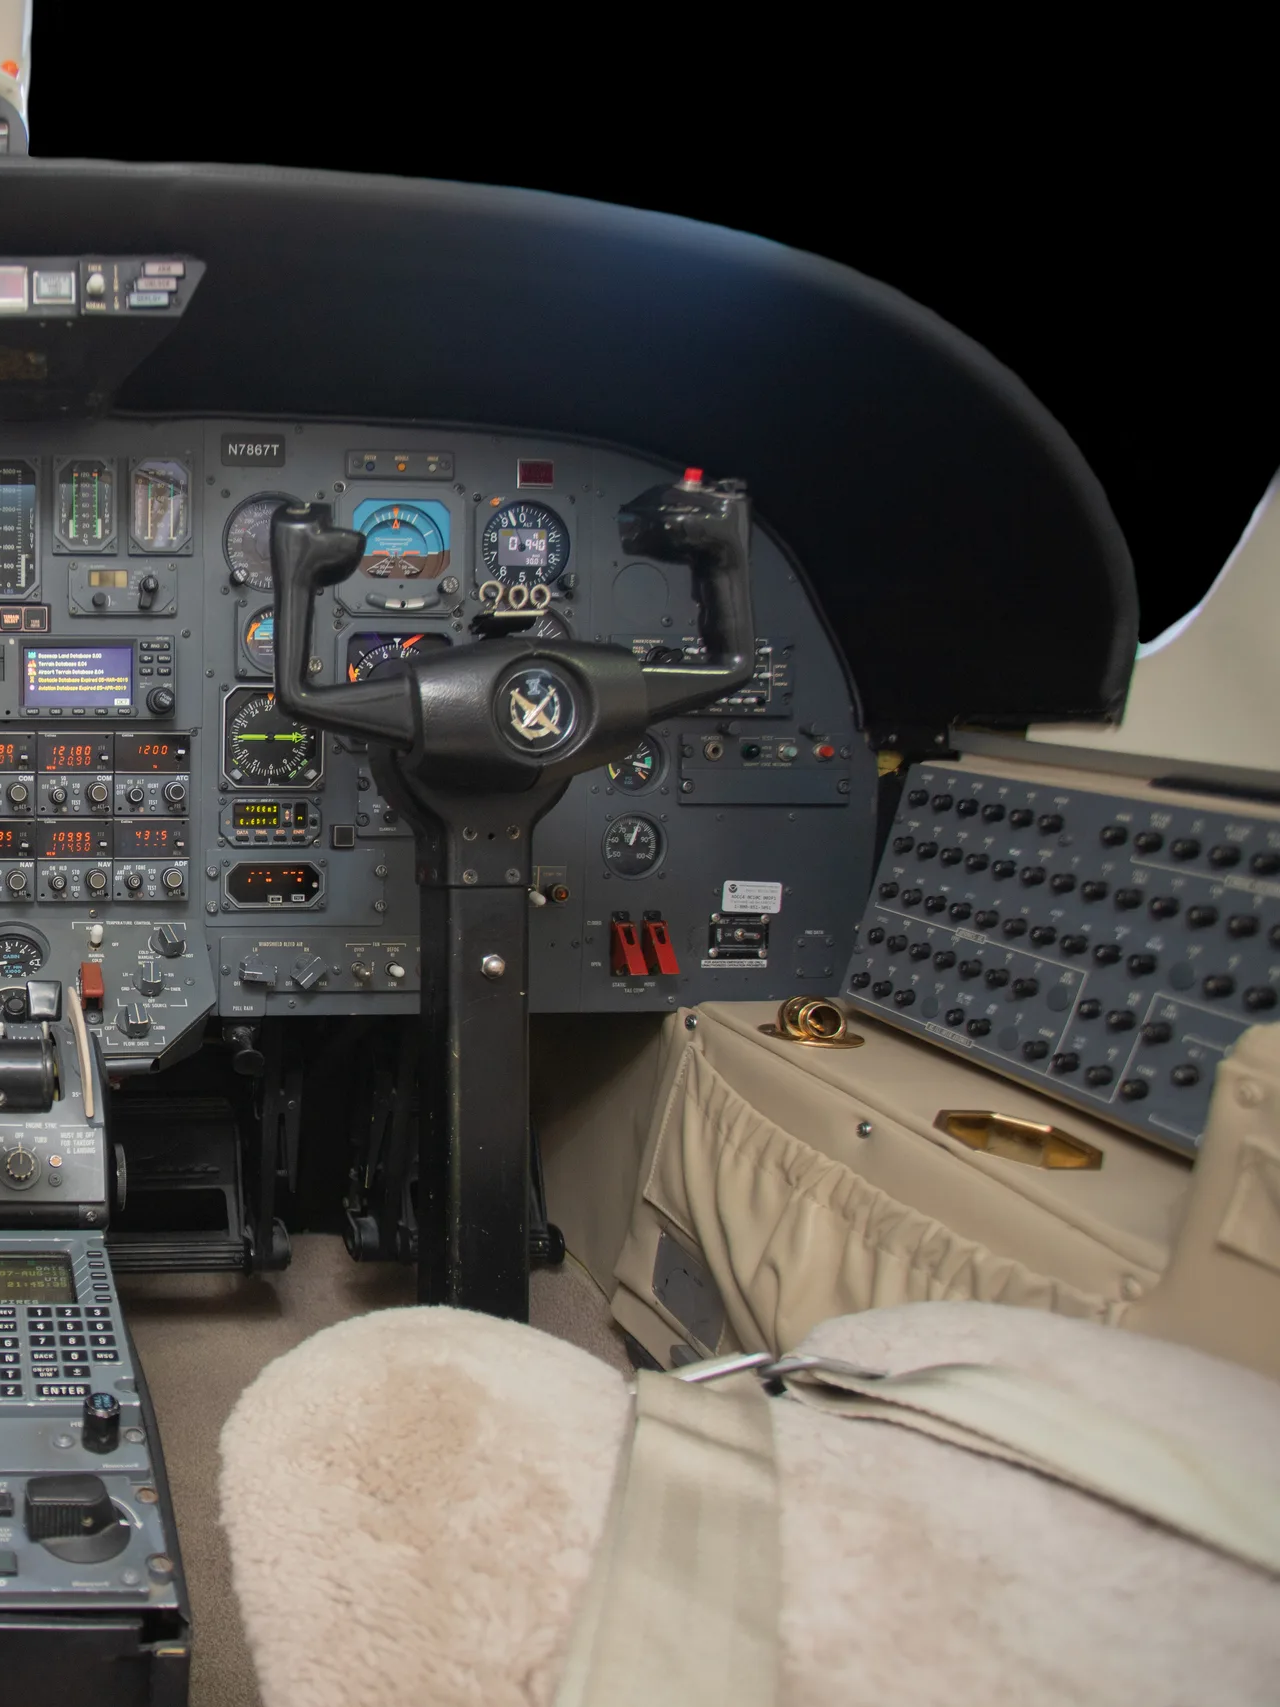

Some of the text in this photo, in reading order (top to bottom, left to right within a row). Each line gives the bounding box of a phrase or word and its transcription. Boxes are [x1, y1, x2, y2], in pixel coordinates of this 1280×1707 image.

[229, 444, 279, 455] N7867T
[490, 532, 497, 542] 8
[525, 540, 545, 550] 940
[491, 552, 497, 561] 7
[519, 572, 525, 582] 5
[53, 746, 91, 756] 121.80
[138, 746, 168, 755] 1200
[53, 832, 91, 842] 109.95
